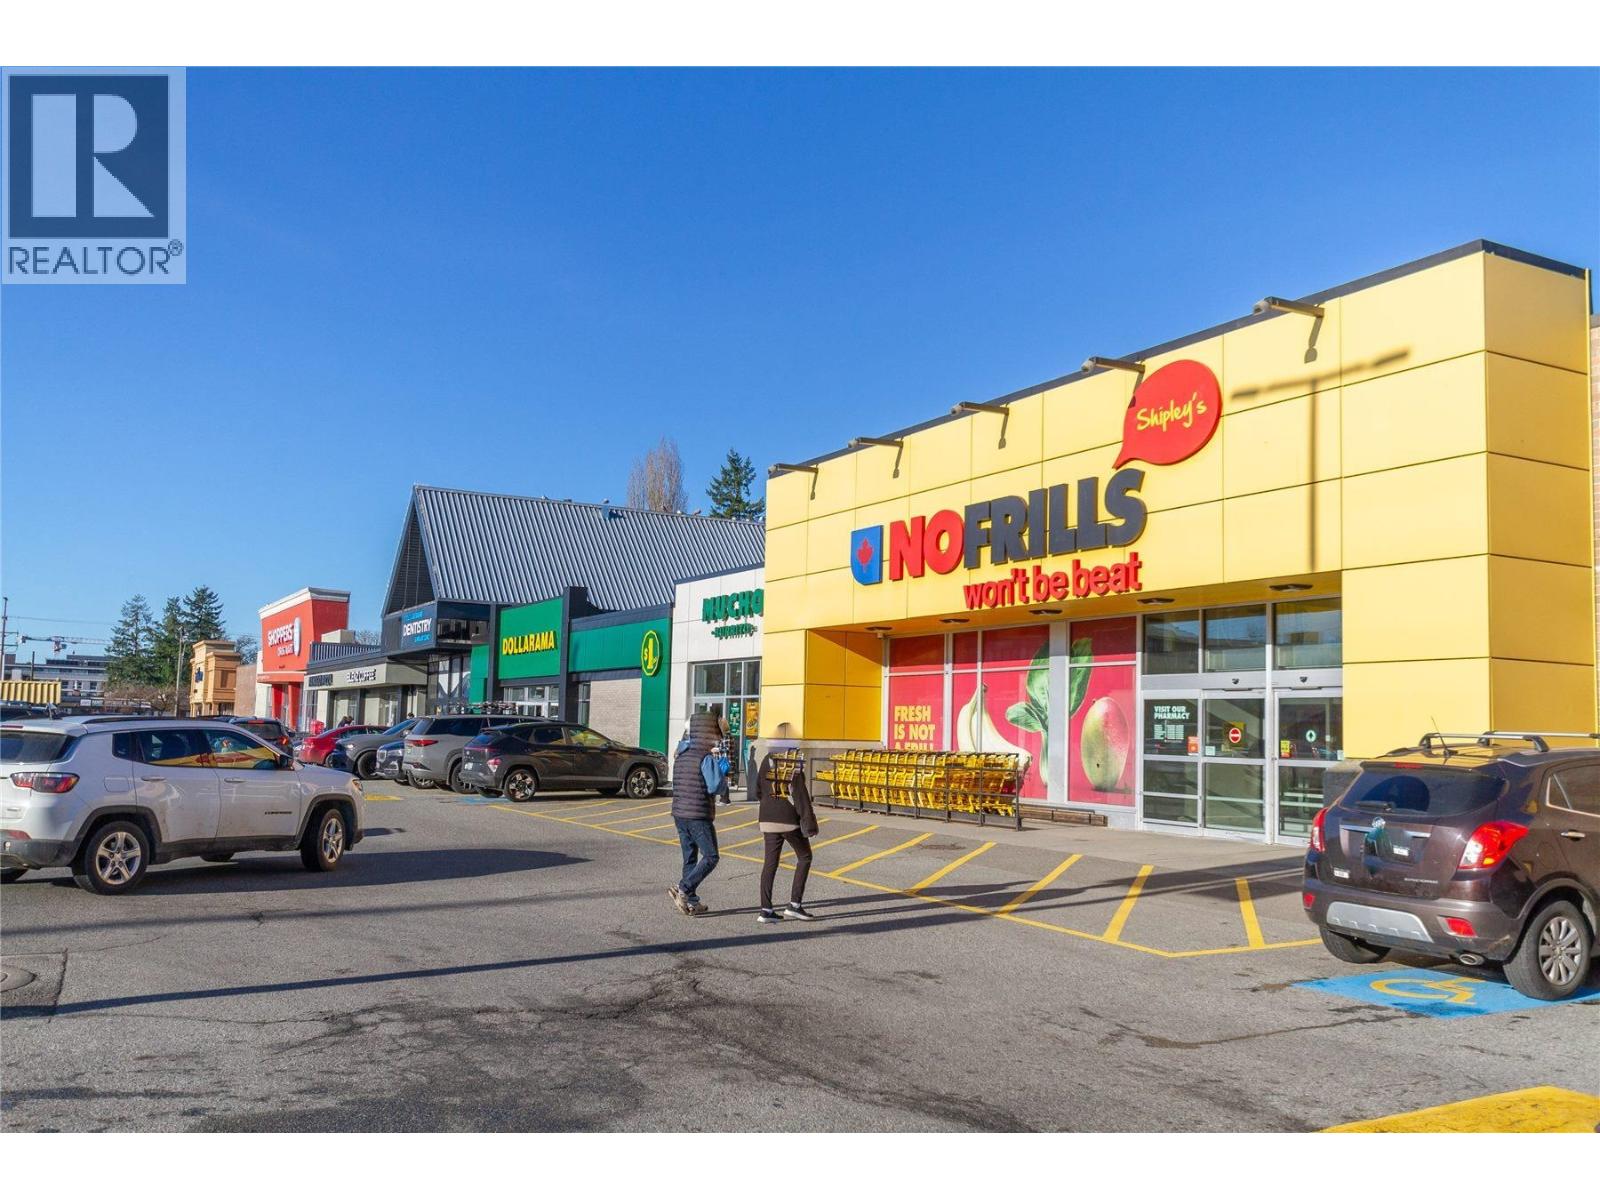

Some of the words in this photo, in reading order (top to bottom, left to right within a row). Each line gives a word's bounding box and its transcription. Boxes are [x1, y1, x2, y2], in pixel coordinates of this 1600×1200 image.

[1136, 391, 1207, 432] Shipley's
[963, 567, 1030, 609] won't
[1032, 565, 1069, 602] be
[1072, 552, 1142, 598] beat
[702, 588, 764, 622] MUCHO
[268, 624, 294, 645] SHOPPERS
[403, 618, 432, 636] DENTISTRY
[502, 630, 555, 655] DOLLARAMA
[894, 705, 932, 722] FRESH
[1153, 712, 1190, 720] PHARMACY
[1171, 705, 1186, 713] OUR
[894, 724, 906, 740] IS
[909, 724, 936, 741] NOT
